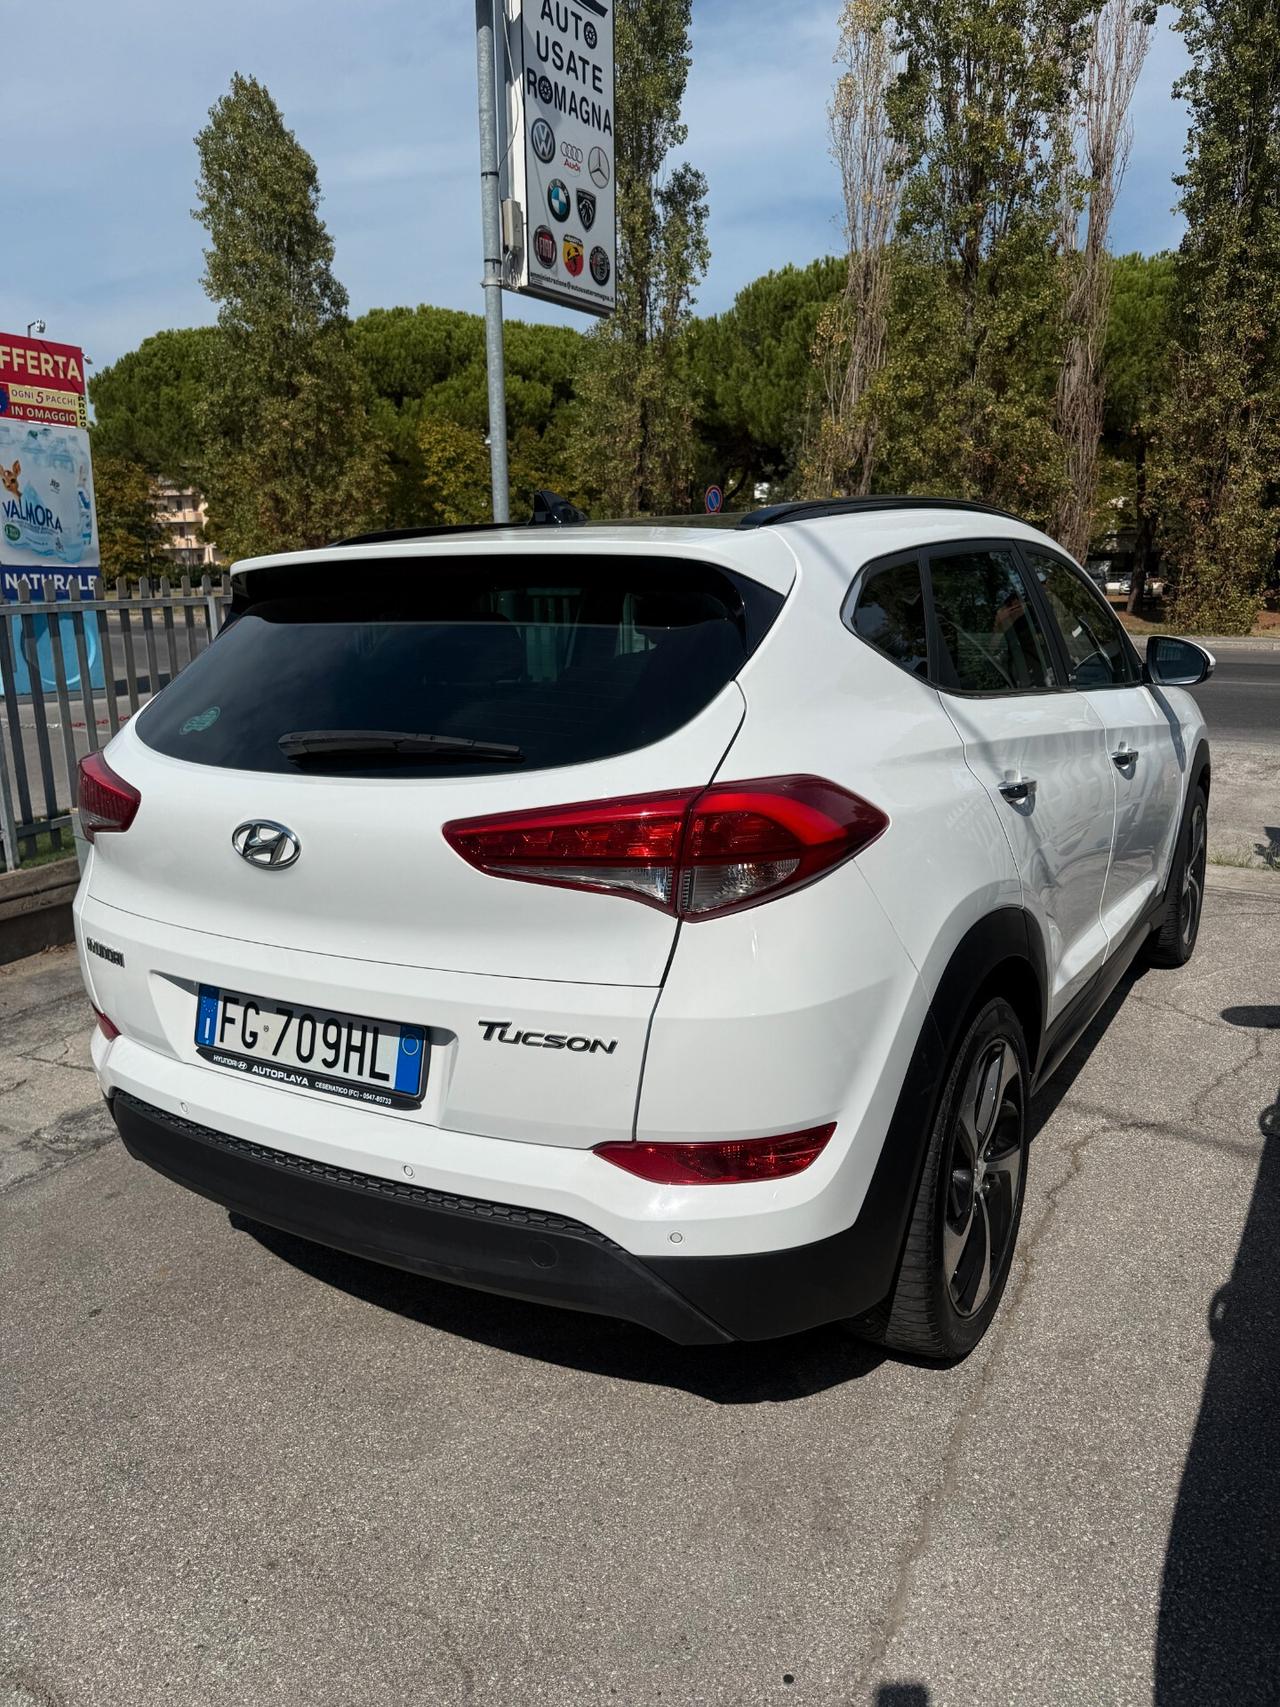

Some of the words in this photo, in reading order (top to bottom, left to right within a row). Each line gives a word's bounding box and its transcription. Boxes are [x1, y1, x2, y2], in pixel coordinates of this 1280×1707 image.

[541, 0, 598, 49] AUTO
[536, 30, 603, 94] USATE
[526, 67, 612, 136] ROMAGNA
[11, 389, 34, 399] OGNI
[36, 391, 44, 404] 5
[45, 395, 76, 406] PACCHI
[11, 405, 23, 416] IN
[26, 407, 77, 423] OMAGGIO
[2, 499, 63, 534] VALMORA
[219, 995, 260, 1050] FG
[271, 1007, 391, 1083] 709HL
[213, 1054, 238, 1067] HYUNDAI
[252, 1065, 309, 1086] AUTOPLAYA
[314, 1081, 348, 1095] CESENATICO
[348, 1088, 360, 1098] (FC)
